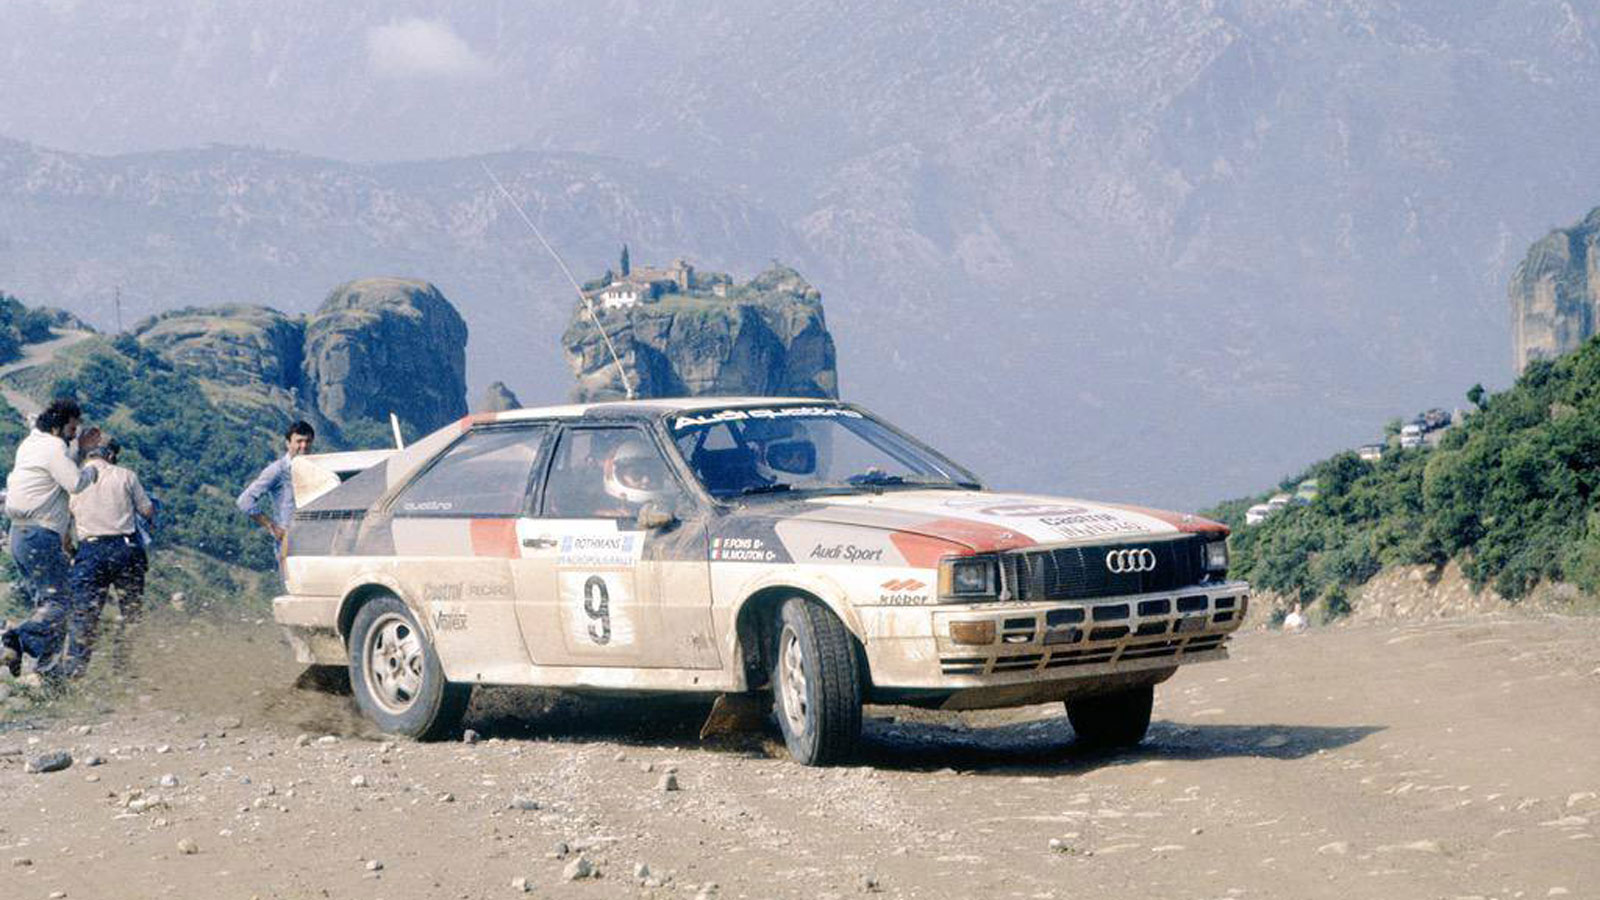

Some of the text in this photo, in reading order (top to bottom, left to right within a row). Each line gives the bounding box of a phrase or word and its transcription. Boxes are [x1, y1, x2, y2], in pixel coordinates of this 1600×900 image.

[675, 407, 863, 430] Audi quattro
[403, 501, 453, 511] quattro
[574, 538, 621, 550] ROTHMANS
[810, 544, 883, 562] Audi Sport
[583, 574, 612, 646] 9
